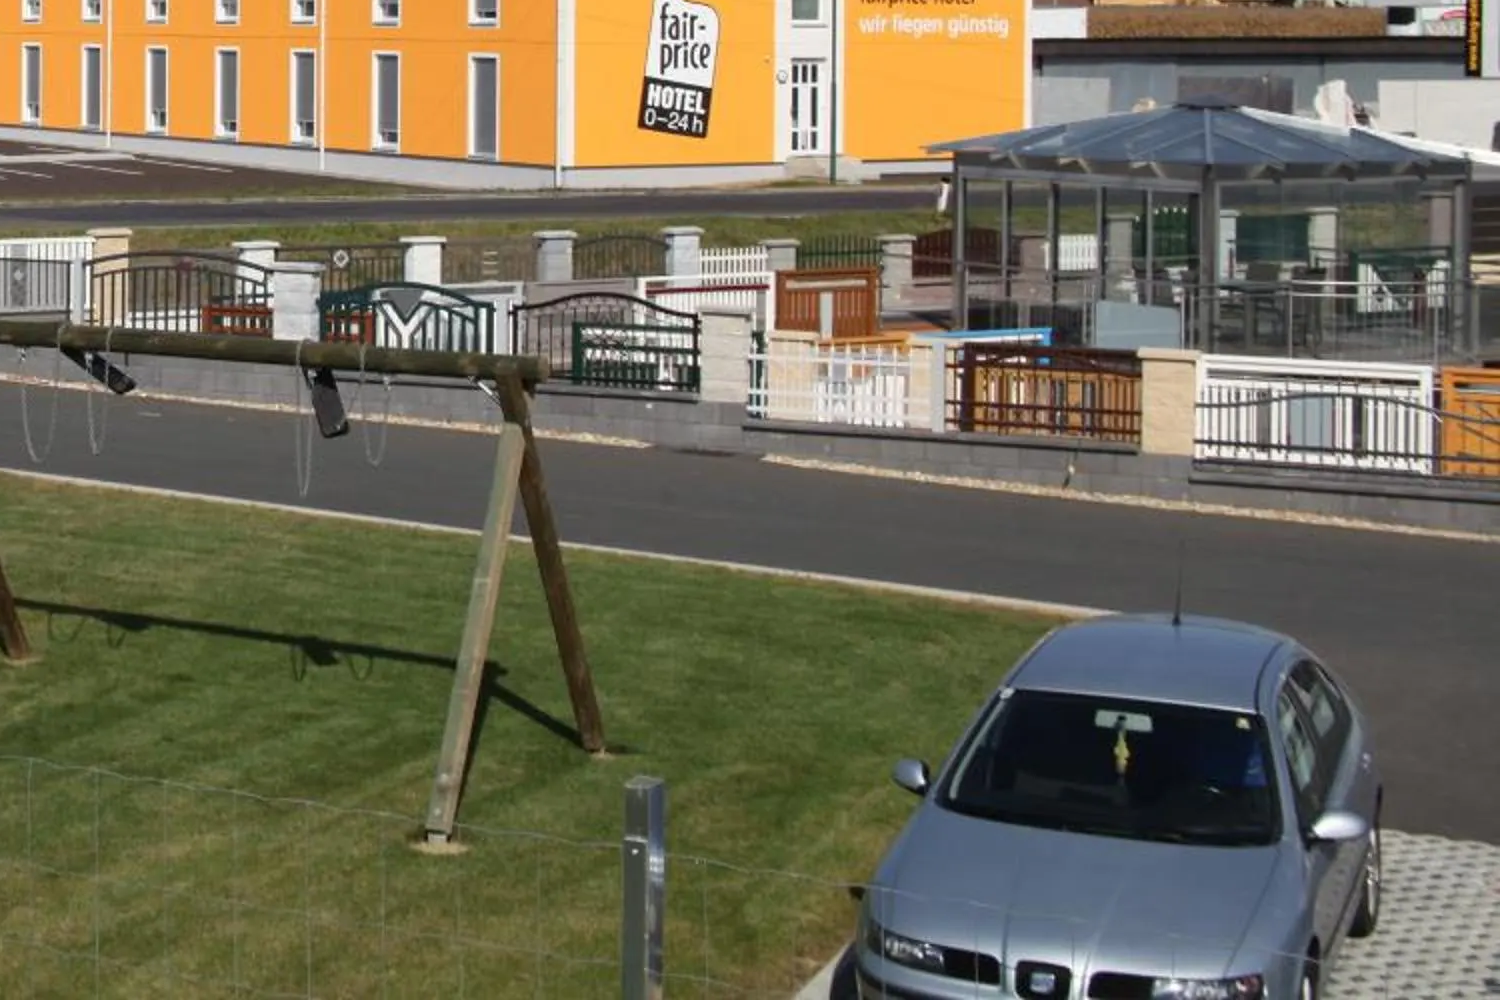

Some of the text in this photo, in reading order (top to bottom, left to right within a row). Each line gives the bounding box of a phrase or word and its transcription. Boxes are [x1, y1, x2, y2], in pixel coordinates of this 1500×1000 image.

[660, 2, 706, 40] fair-
[859, 14, 1009, 39] wir liegen günstig
[660, 41, 711, 75] price
[647, 83, 705, 114] HOTEL
[691, 116, 703, 133] h
